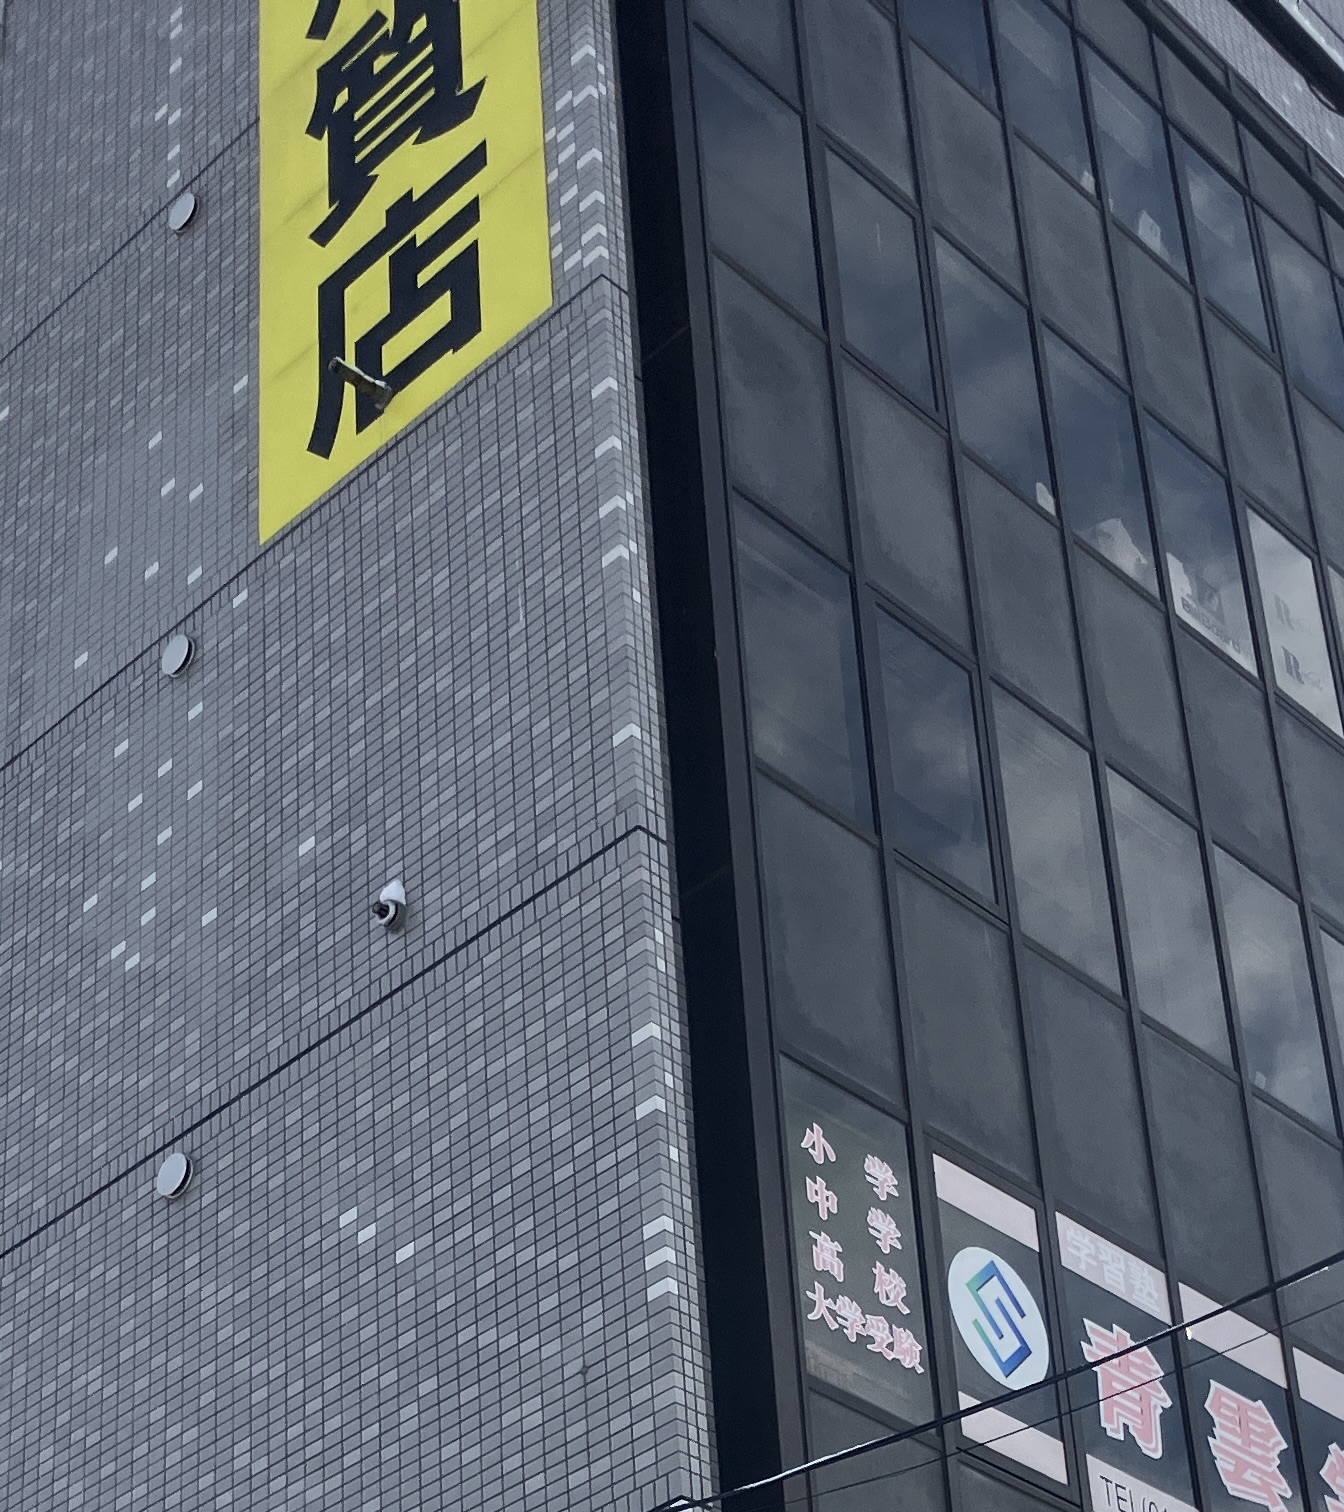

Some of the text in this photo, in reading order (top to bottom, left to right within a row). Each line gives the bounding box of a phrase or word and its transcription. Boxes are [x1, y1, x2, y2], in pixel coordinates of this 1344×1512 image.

[306, 0, 487, 460] 質店
[806, 1280, 925, 1374] 大学受験
